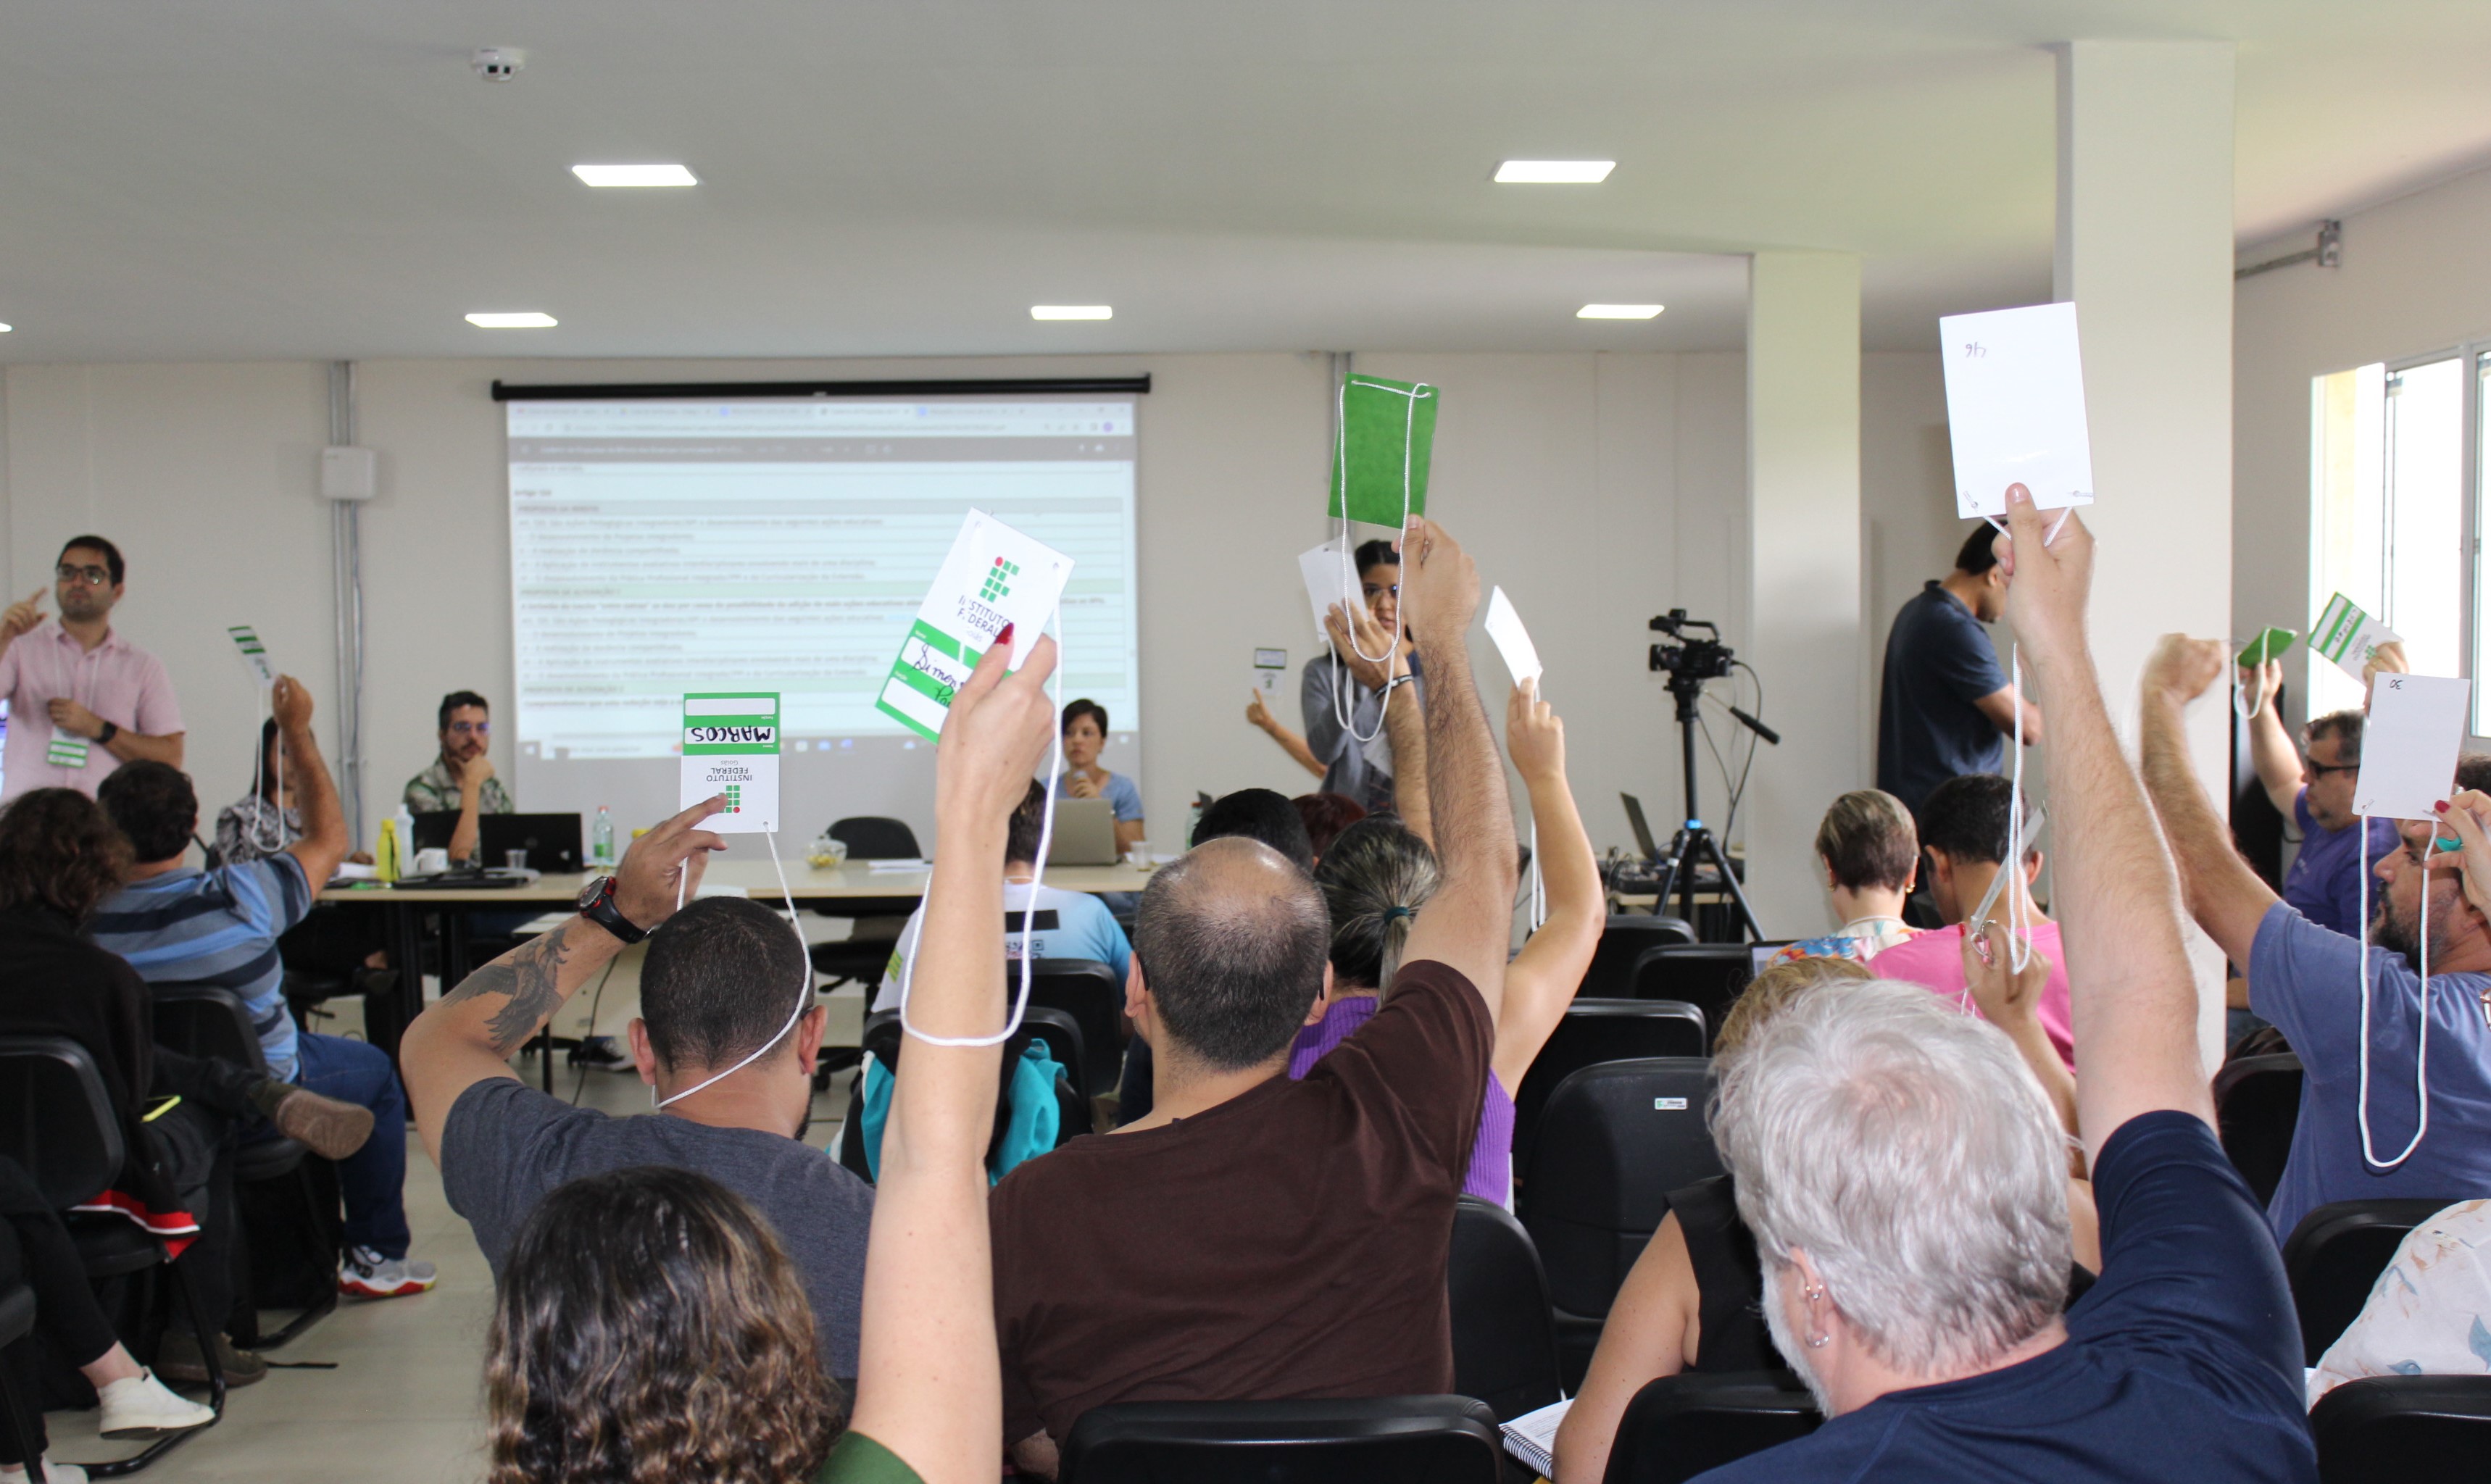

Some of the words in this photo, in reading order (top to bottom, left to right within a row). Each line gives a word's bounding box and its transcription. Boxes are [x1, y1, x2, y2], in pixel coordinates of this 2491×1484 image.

[957, 608, 998, 638] FDERAL
[912, 643, 965, 688] Simon
[691, 725, 770, 743] MARCOS
